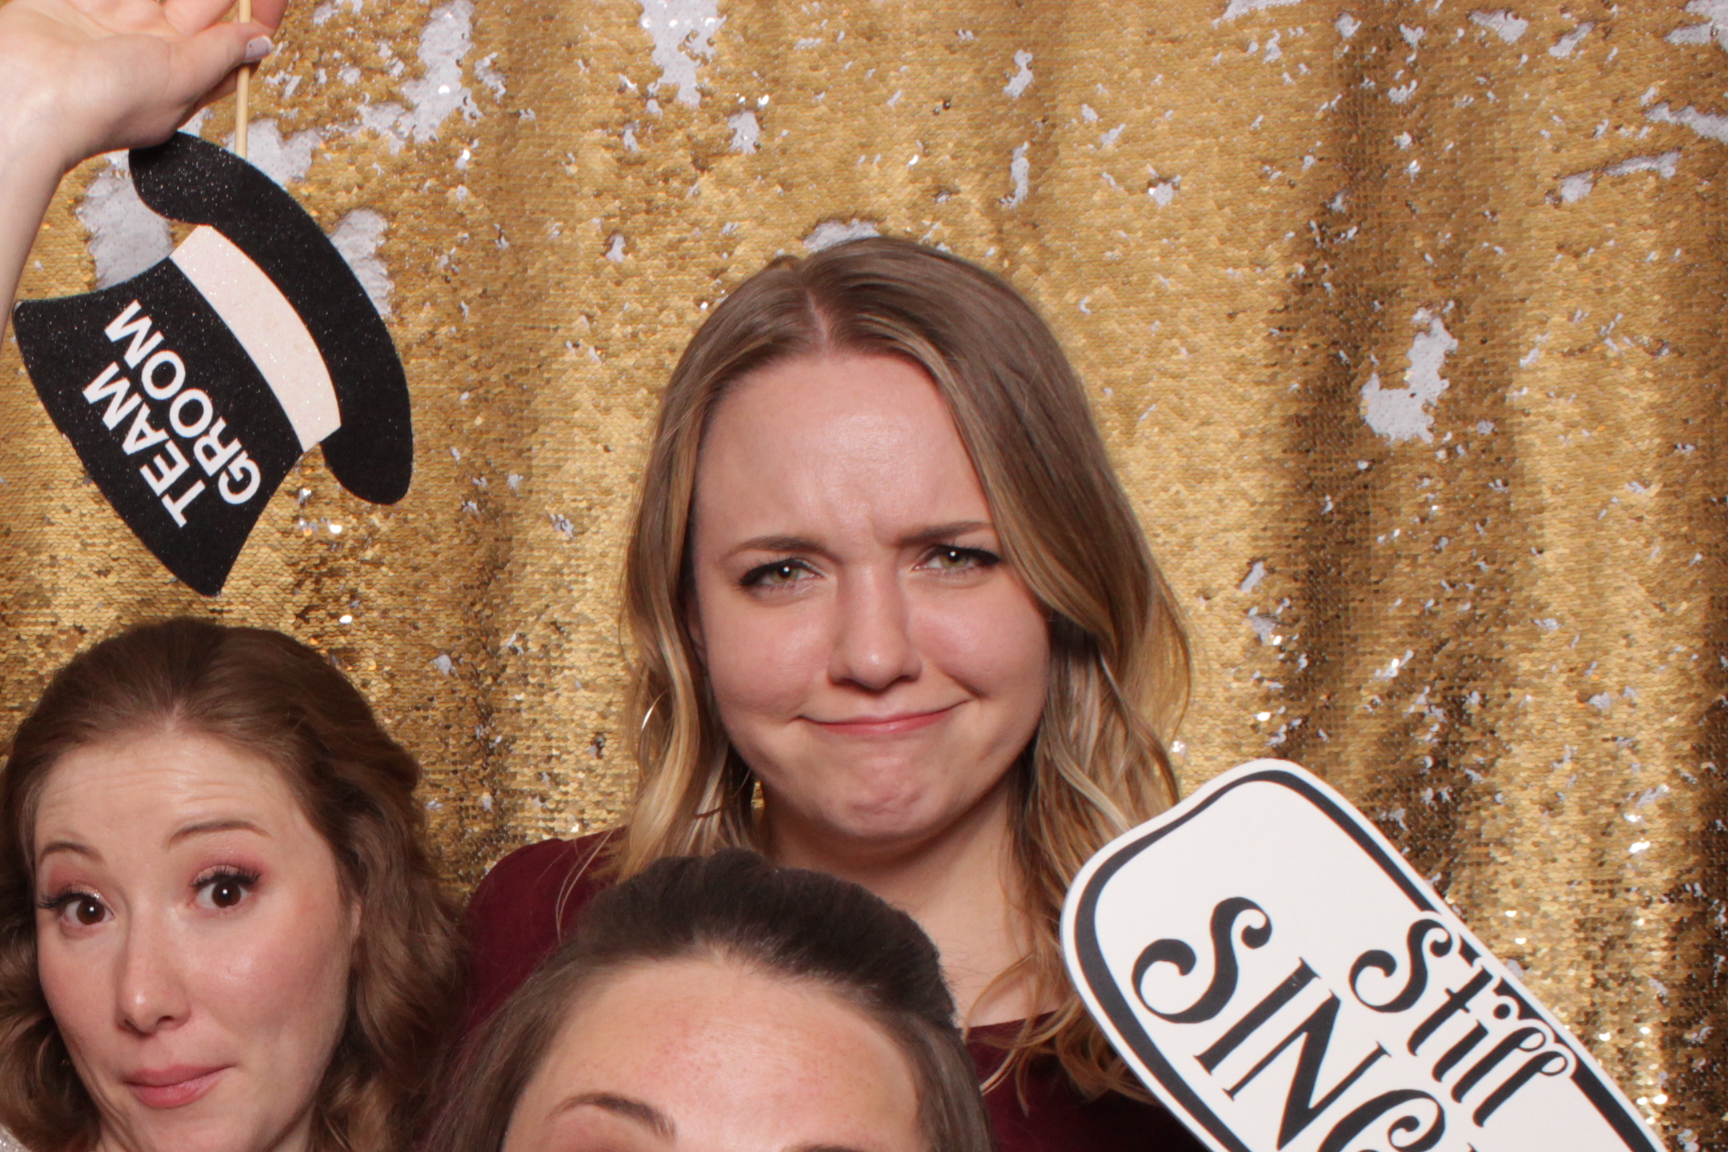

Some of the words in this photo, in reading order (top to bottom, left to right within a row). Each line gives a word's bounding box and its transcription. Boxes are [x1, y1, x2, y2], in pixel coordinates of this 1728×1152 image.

[81, 361, 206, 529] TEAM
[103, 299, 262, 506] GROOM
[1348, 917, 1569, 1129] Still
